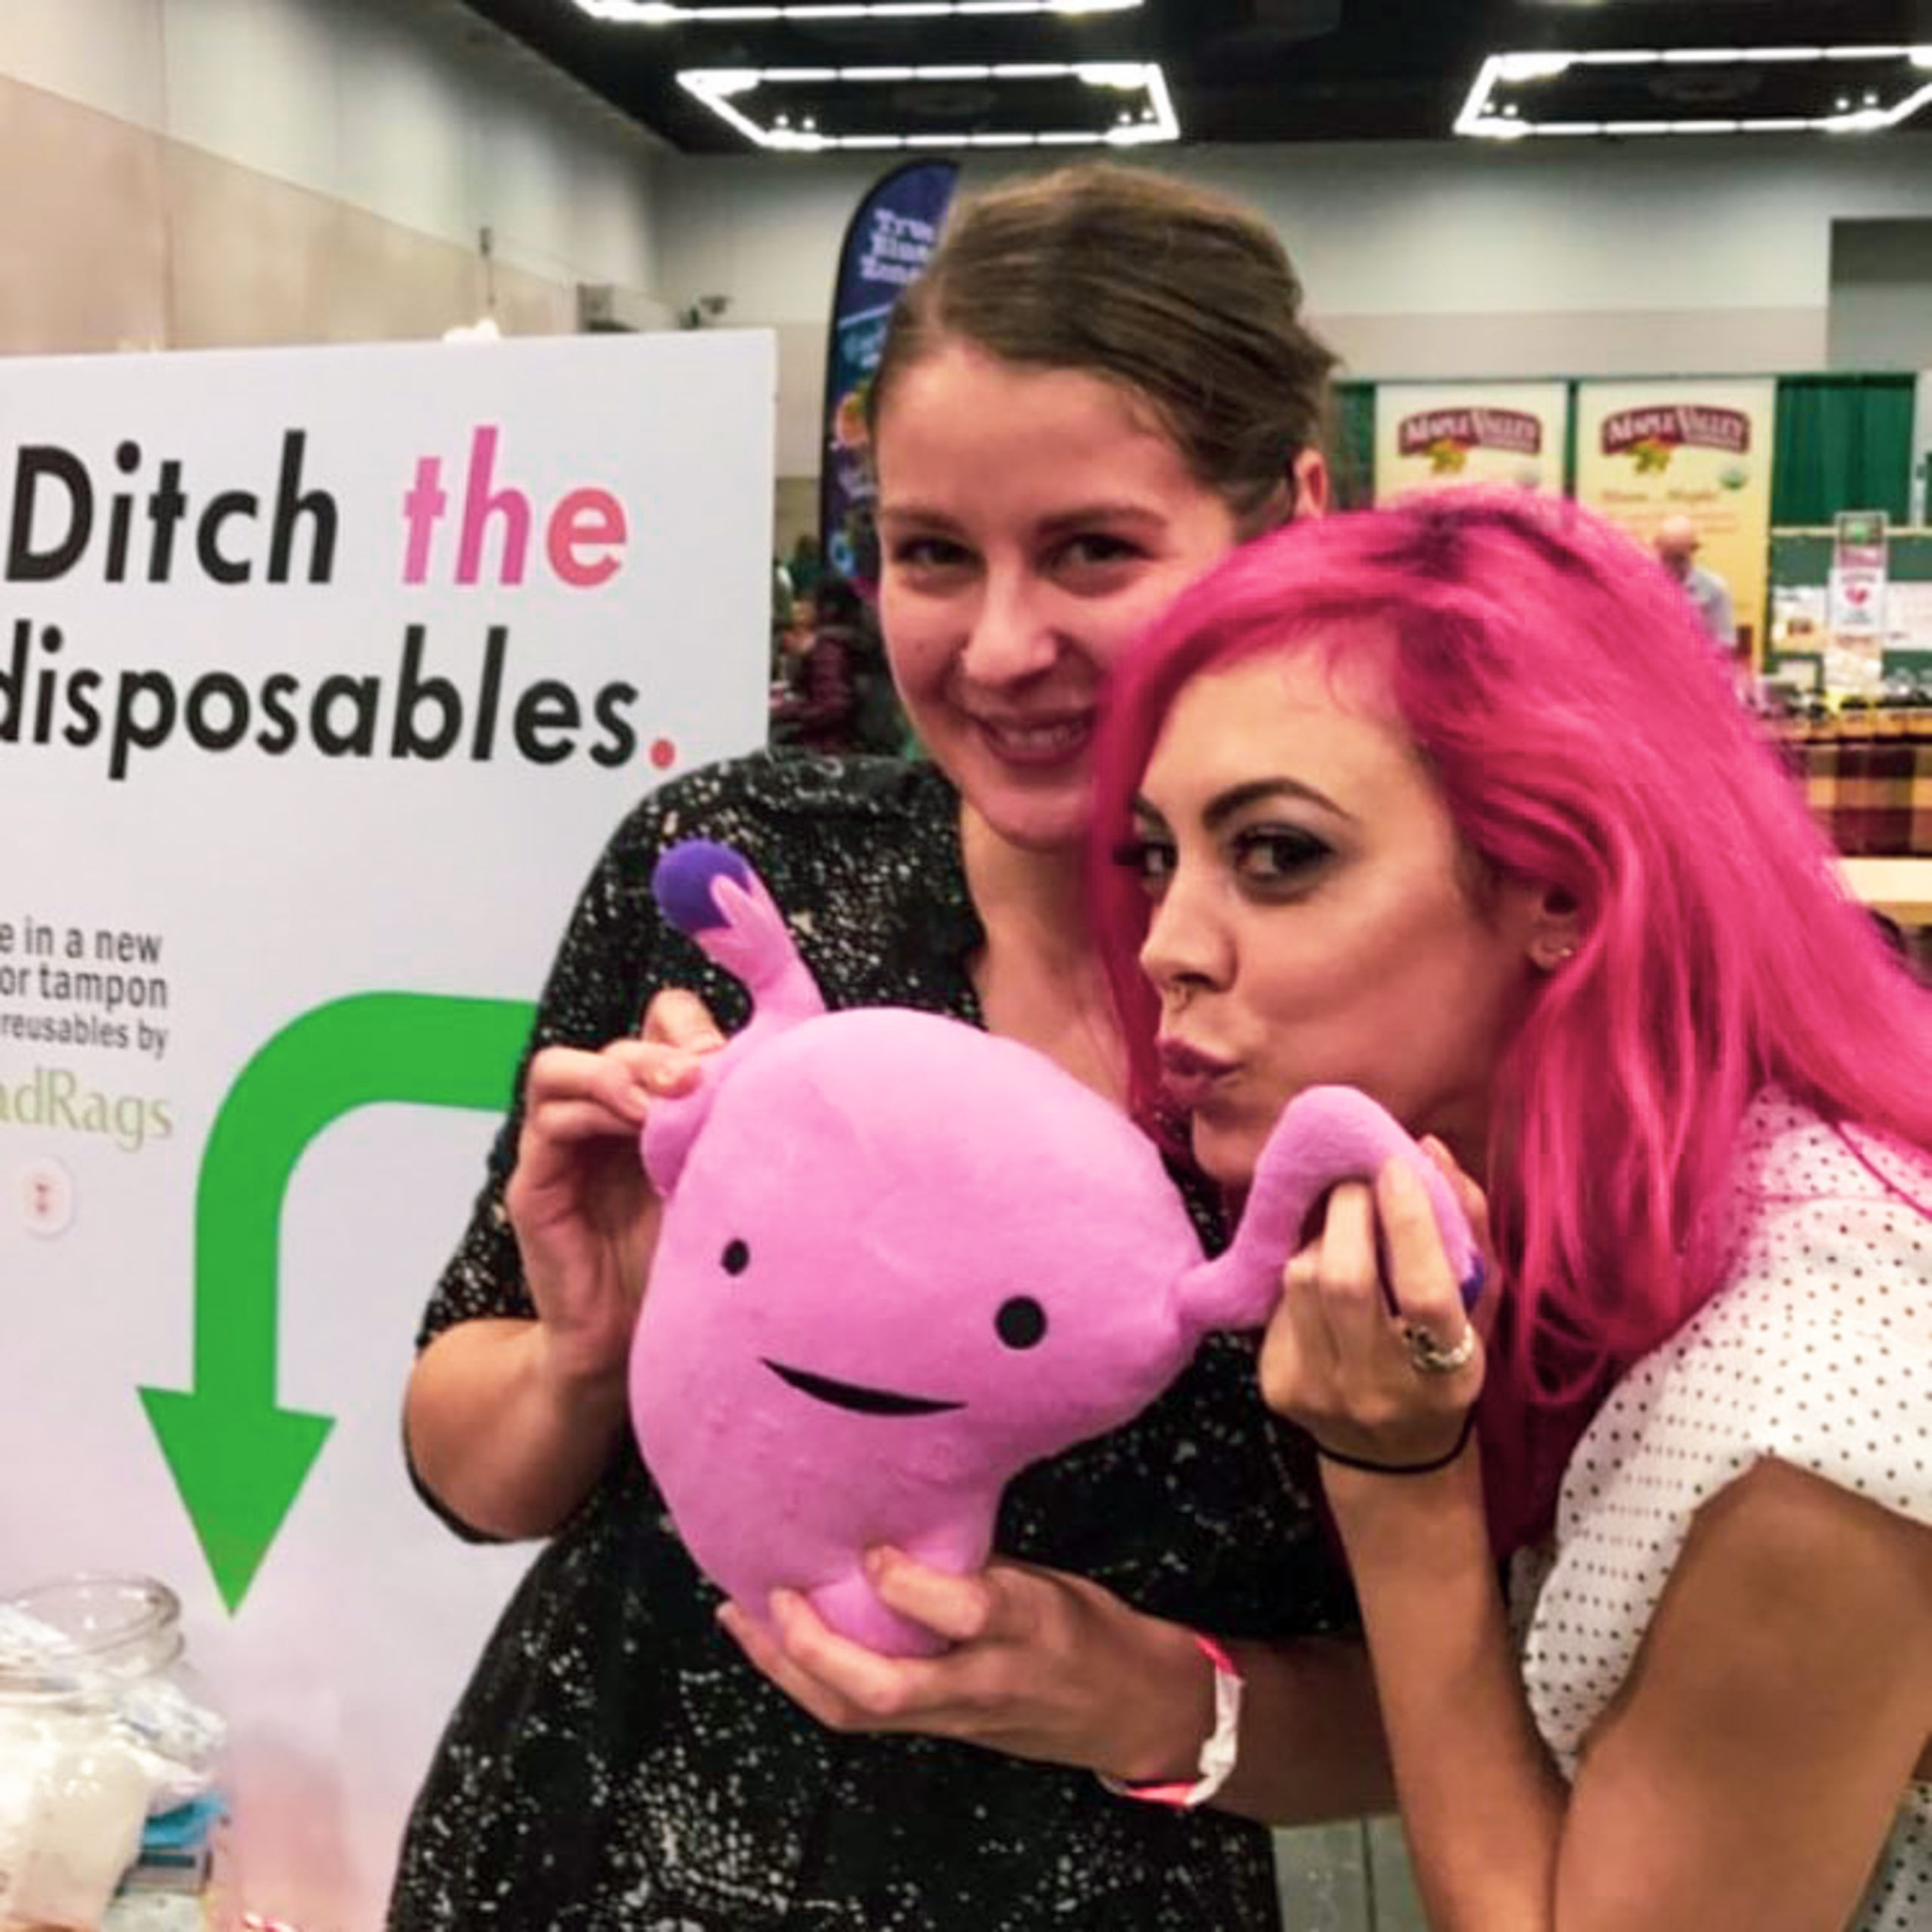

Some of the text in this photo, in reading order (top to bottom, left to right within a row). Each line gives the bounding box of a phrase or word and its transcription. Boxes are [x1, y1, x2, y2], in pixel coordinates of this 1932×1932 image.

[5, 426, 627, 586] Ditch the
[0, 619, 675, 780] disposables.
[25, 915, 53, 956] in
[66, 928, 83, 958] a
[94, 930, 162, 963] new
[0, 961, 167, 1013] or tampon
[0, 1014, 168, 1060] reusables by
